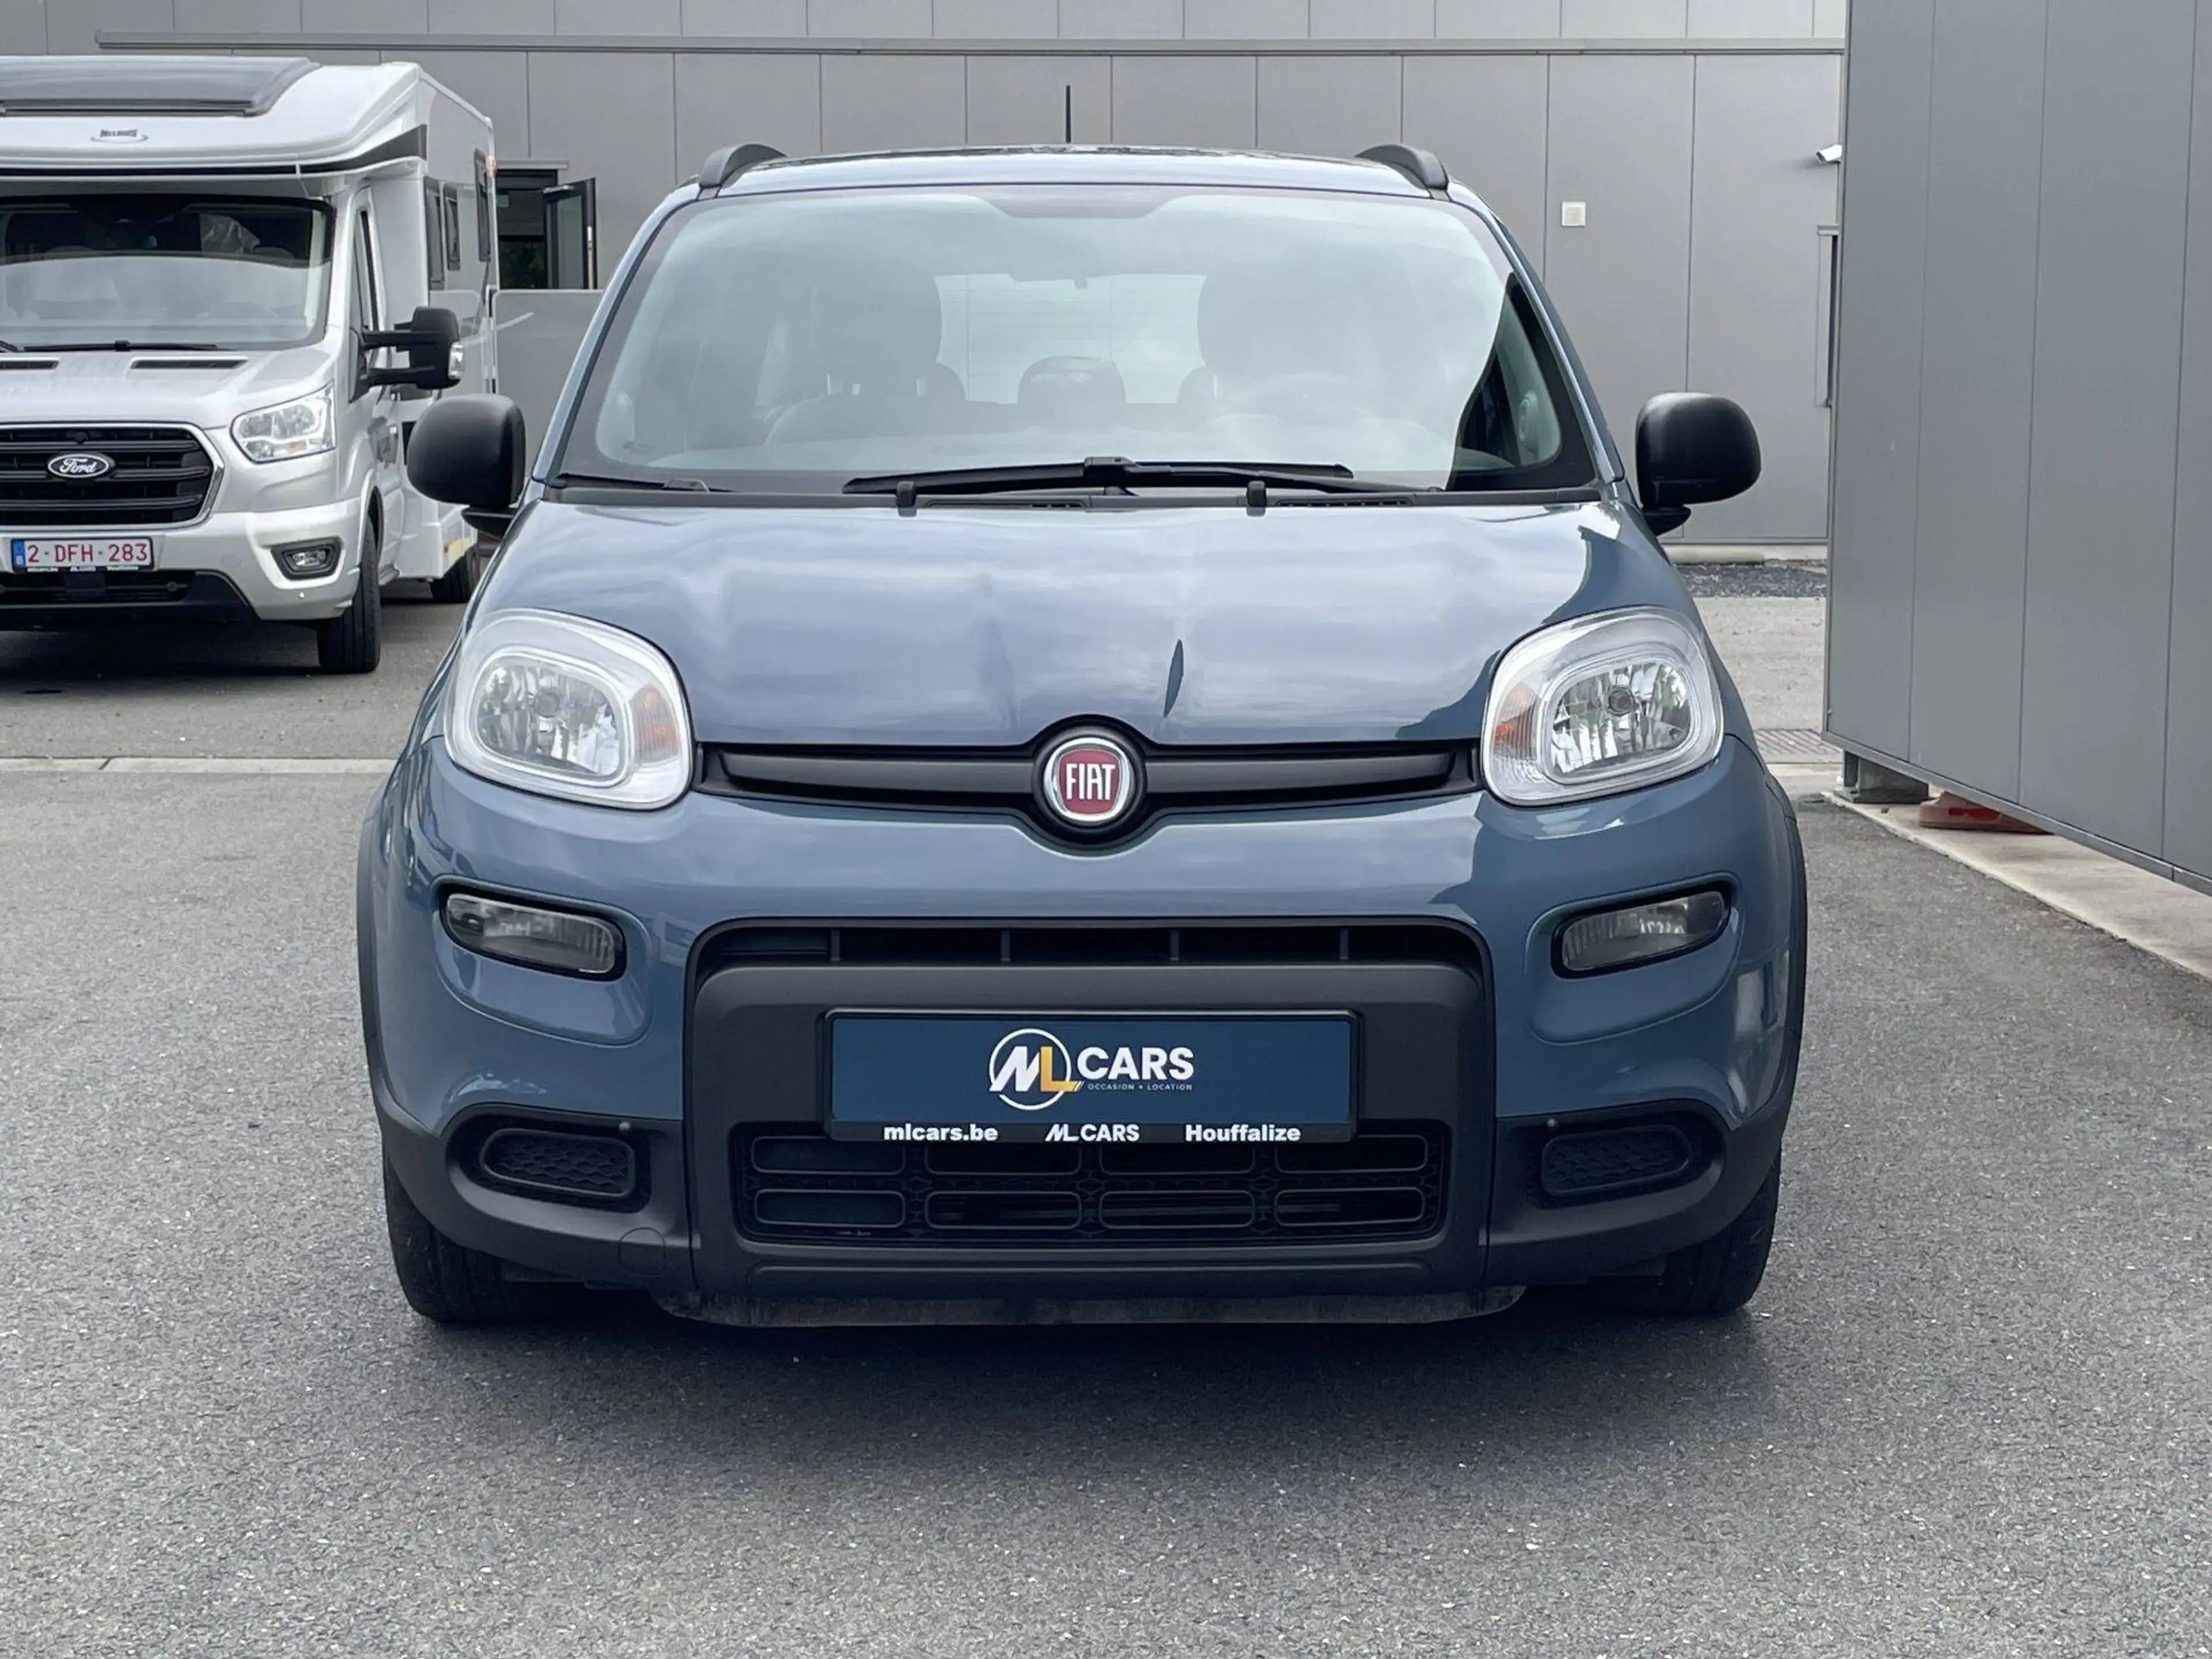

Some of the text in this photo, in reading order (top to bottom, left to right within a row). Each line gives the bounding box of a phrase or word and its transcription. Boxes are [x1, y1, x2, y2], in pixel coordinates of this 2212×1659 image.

[59, 458, 97, 473] Ford
[1066, 763, 1116, 800] FIAT
[1077, 1047, 1194, 1080] CARS
[1147, 1083, 1193, 1091] LOCATION
[884, 1123, 998, 1141] mlcars.be
[1185, 1124, 1301, 1142] Houffalize
